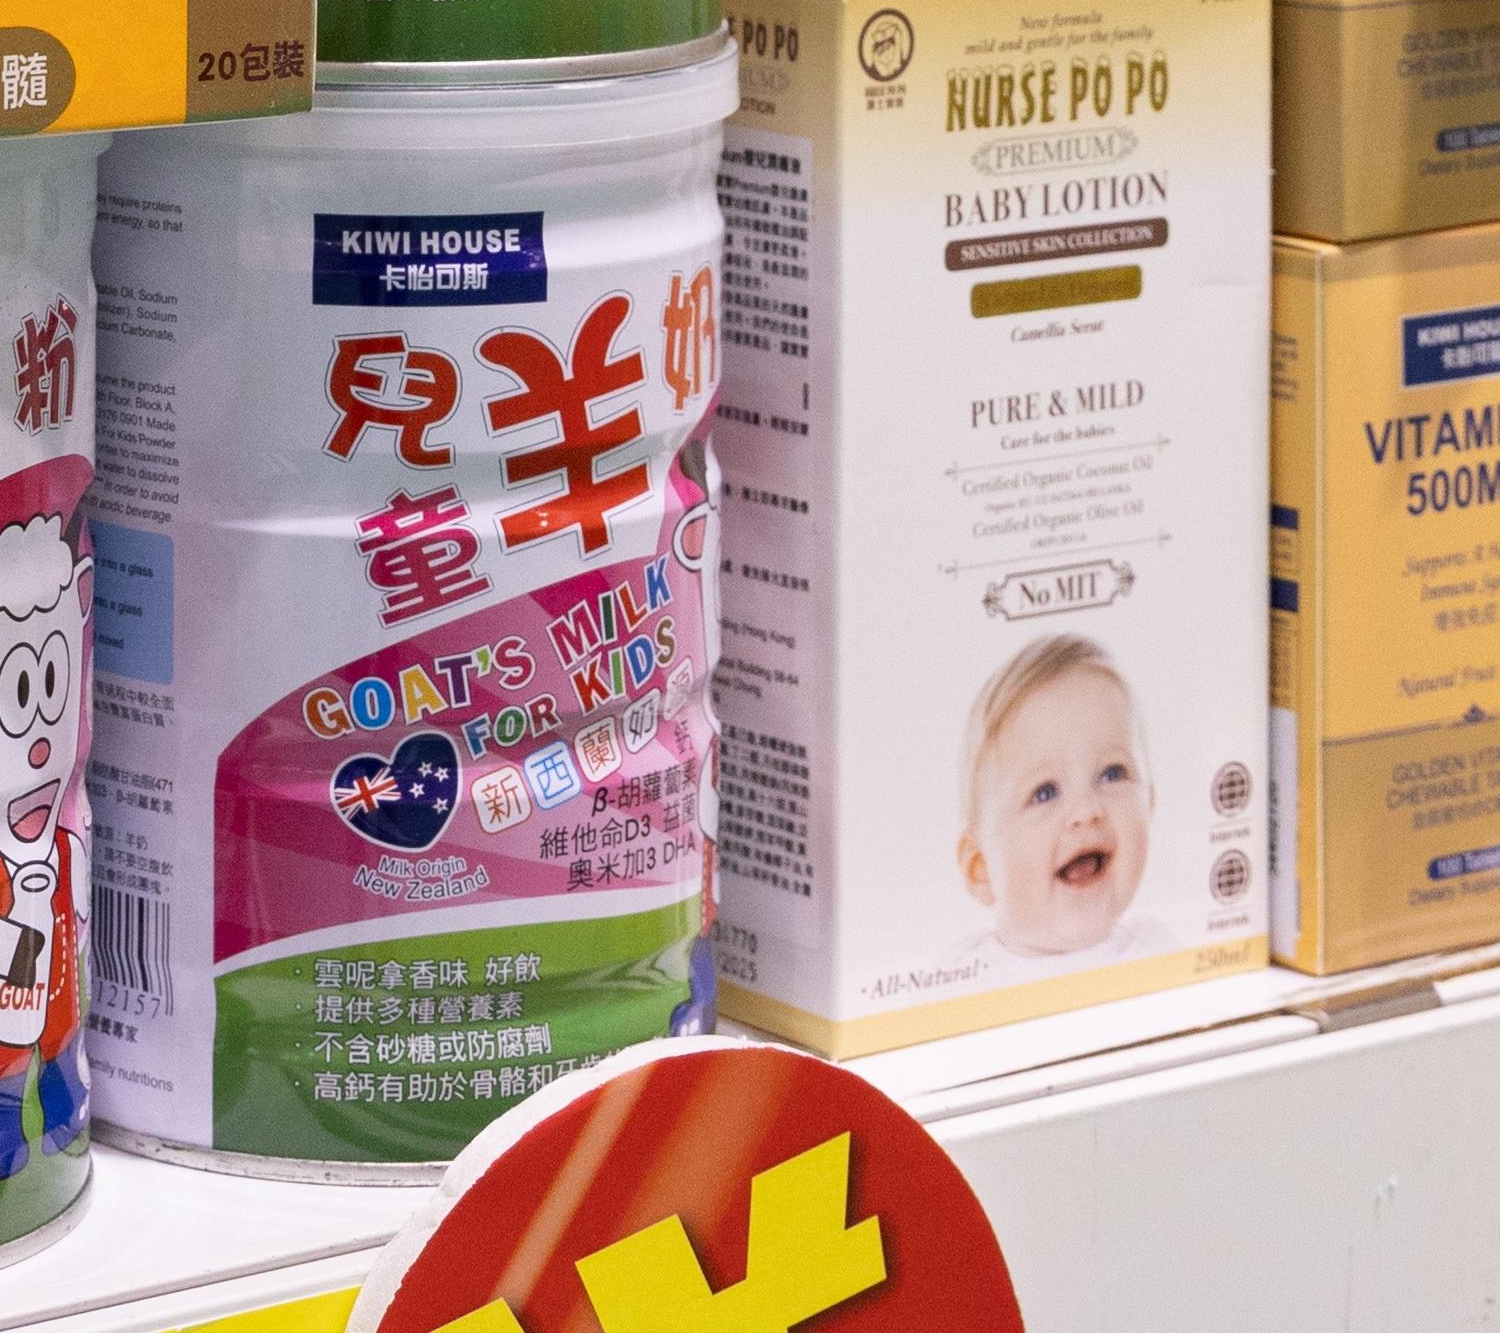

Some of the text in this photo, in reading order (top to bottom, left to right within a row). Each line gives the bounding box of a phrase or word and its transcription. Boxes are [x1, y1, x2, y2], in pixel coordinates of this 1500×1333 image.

[197, 38, 306, 84] 20包裝
[944, 171, 1170, 228] BABY LOTION
[341, 228, 522, 257] KIWI HOUSE
[378, 263, 490, 293] 卡怡可斯
[971, 380, 1146, 427] PURE & MILD
[1018, 572, 1102, 609] No MIT
[354, 866, 490, 902] New Zealand
[314, 952, 541, 990] 雲呢拿香味 好飲
[314, 990, 524, 1025] 提供多種營養素
[313, 1024, 553, 1065] 不含砂糖或防腐劑
